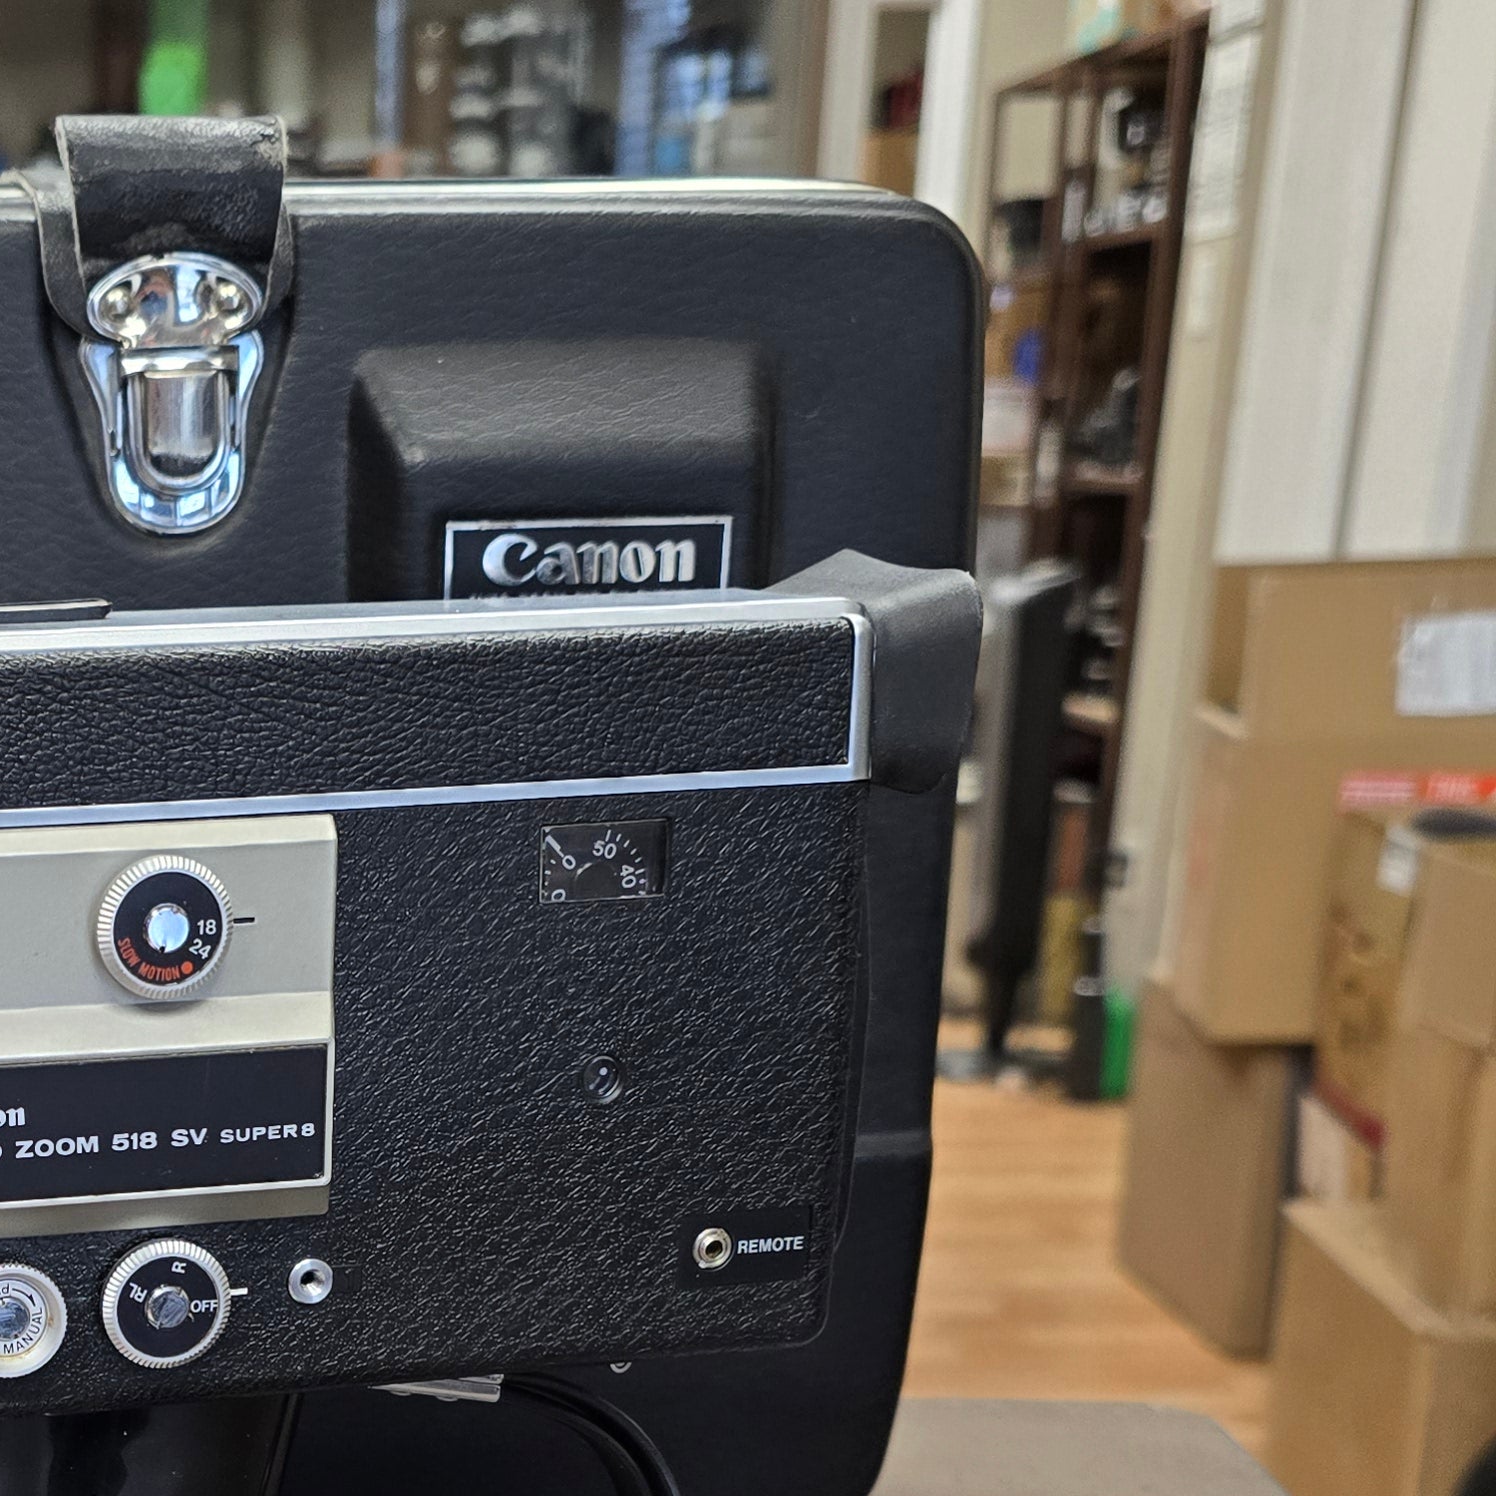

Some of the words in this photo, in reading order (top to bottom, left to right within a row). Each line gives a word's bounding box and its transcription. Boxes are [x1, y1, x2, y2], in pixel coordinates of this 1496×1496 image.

[482, 532, 696, 587] Canon
[592, 840, 617, 859] 50
[620, 865, 636, 888] 40
[197, 919, 216, 935] 18
[118, 937, 141, 967] SLOW
[138, 962, 180, 981] MOTION
[189, 938, 211, 959] 24
[15, 1135, 99, 1159] ZOOM
[111, 1130, 158, 1152] 518
[170, 1128, 207, 1148] SV
[737, 1236, 804, 1254] REMOTE
[190, 1300, 218, 1313] OFF
[4, 1307, 42, 1354] MANUAL
